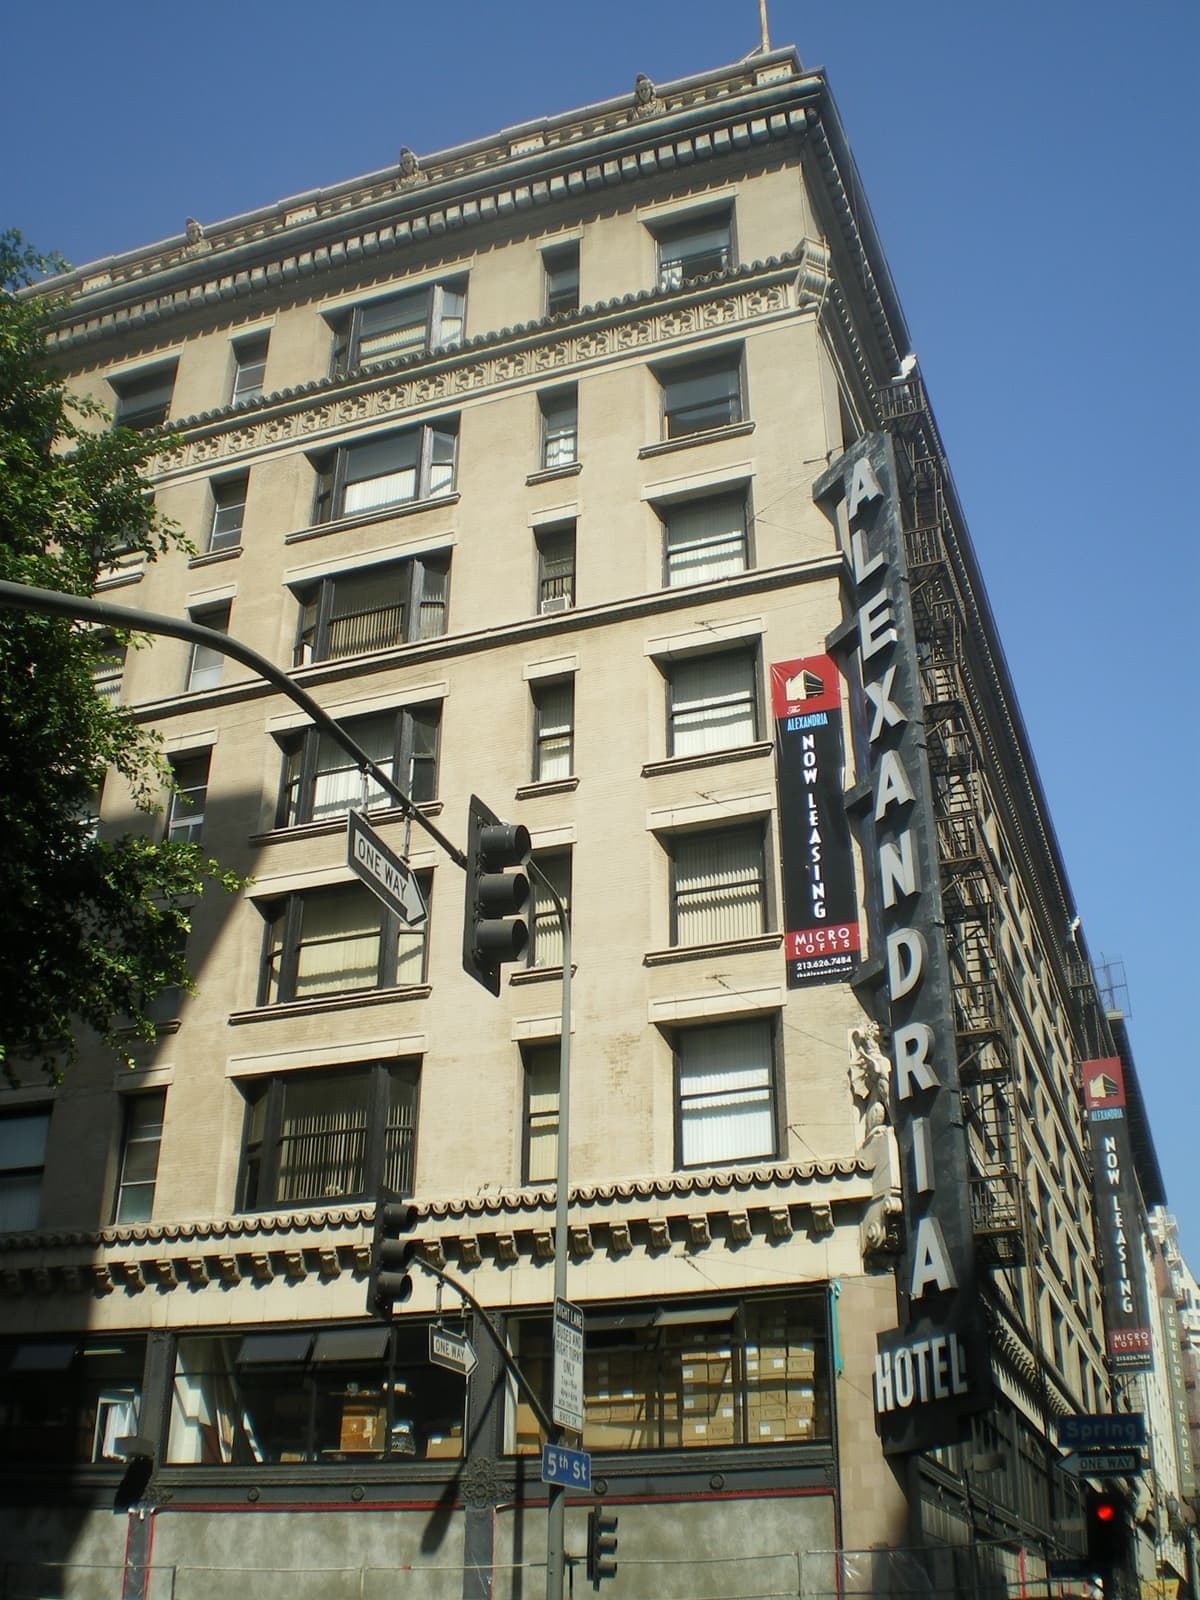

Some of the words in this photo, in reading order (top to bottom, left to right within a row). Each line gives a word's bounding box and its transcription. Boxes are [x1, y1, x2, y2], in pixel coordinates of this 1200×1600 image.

[787, 711, 829, 731] ALEXANDRIA
[803, 734, 818, 785] NOW
[808, 793, 826, 918] LEASING
[358, 838, 382, 876] ONE
[384, 863, 407, 901] WAY
[848, 456, 958, 1298] ALEXANDRIA
[795, 927, 850, 945] MICRO
[795, 939, 850, 955] LOFTS
[1105, 1136, 1119, 1185] NOW
[1113, 1195, 1133, 1313] LEASING
[571, 1310, 582, 1329] LANE
[557, 1323, 571, 1343] BUSES
[1114, 1332, 1149, 1341] MICRO
[435, 1338, 450, 1357] ONE
[450, 1344, 465, 1361] WAY
[563, 1359, 575, 1377] ONLY
[875, 1333, 968, 1414] HOTEL
[1066, 1421, 1137, 1440] Spring
[1177, 1400, 1192, 1473] TRADES
[547, 1454, 568, 1476] 5th
[573, 1460, 587, 1481] St
[1080, 1457, 1101, 1470] ONE
[1107, 1456, 1131, 1469] WAY
